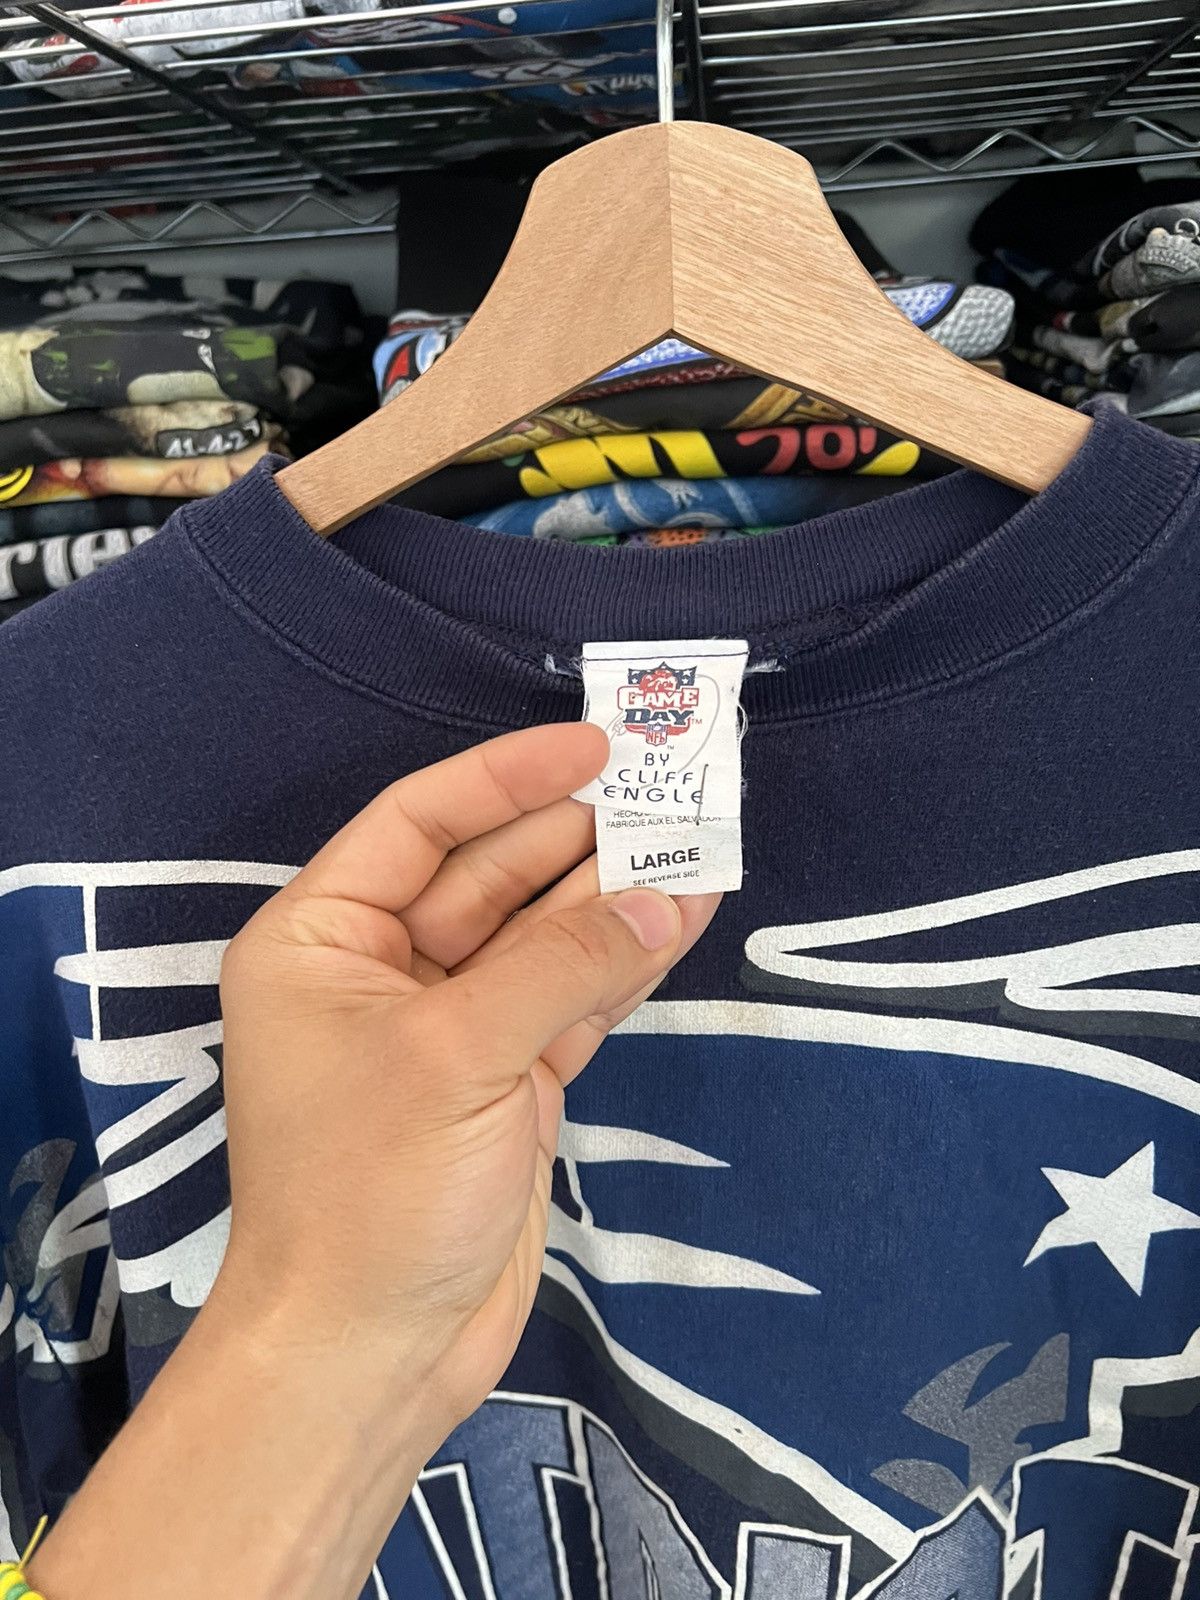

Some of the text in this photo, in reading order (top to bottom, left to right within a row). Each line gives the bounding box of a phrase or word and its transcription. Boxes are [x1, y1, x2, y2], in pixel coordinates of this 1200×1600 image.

[617, 686, 700, 710] GAME
[623, 708, 695, 726] DAY
[644, 752, 670, 767] BY
[617, 768, 694, 785] CLIFF
[603, 785, 703, 805] ENGLE
[606, 819, 647, 829] FABRIQUE
[647, 817, 665, 826] AUX
[665, 816, 676, 825] EL
[630, 847, 701, 871] LARGE
[632, 869, 700, 887] SEE REVERSE SIDE
